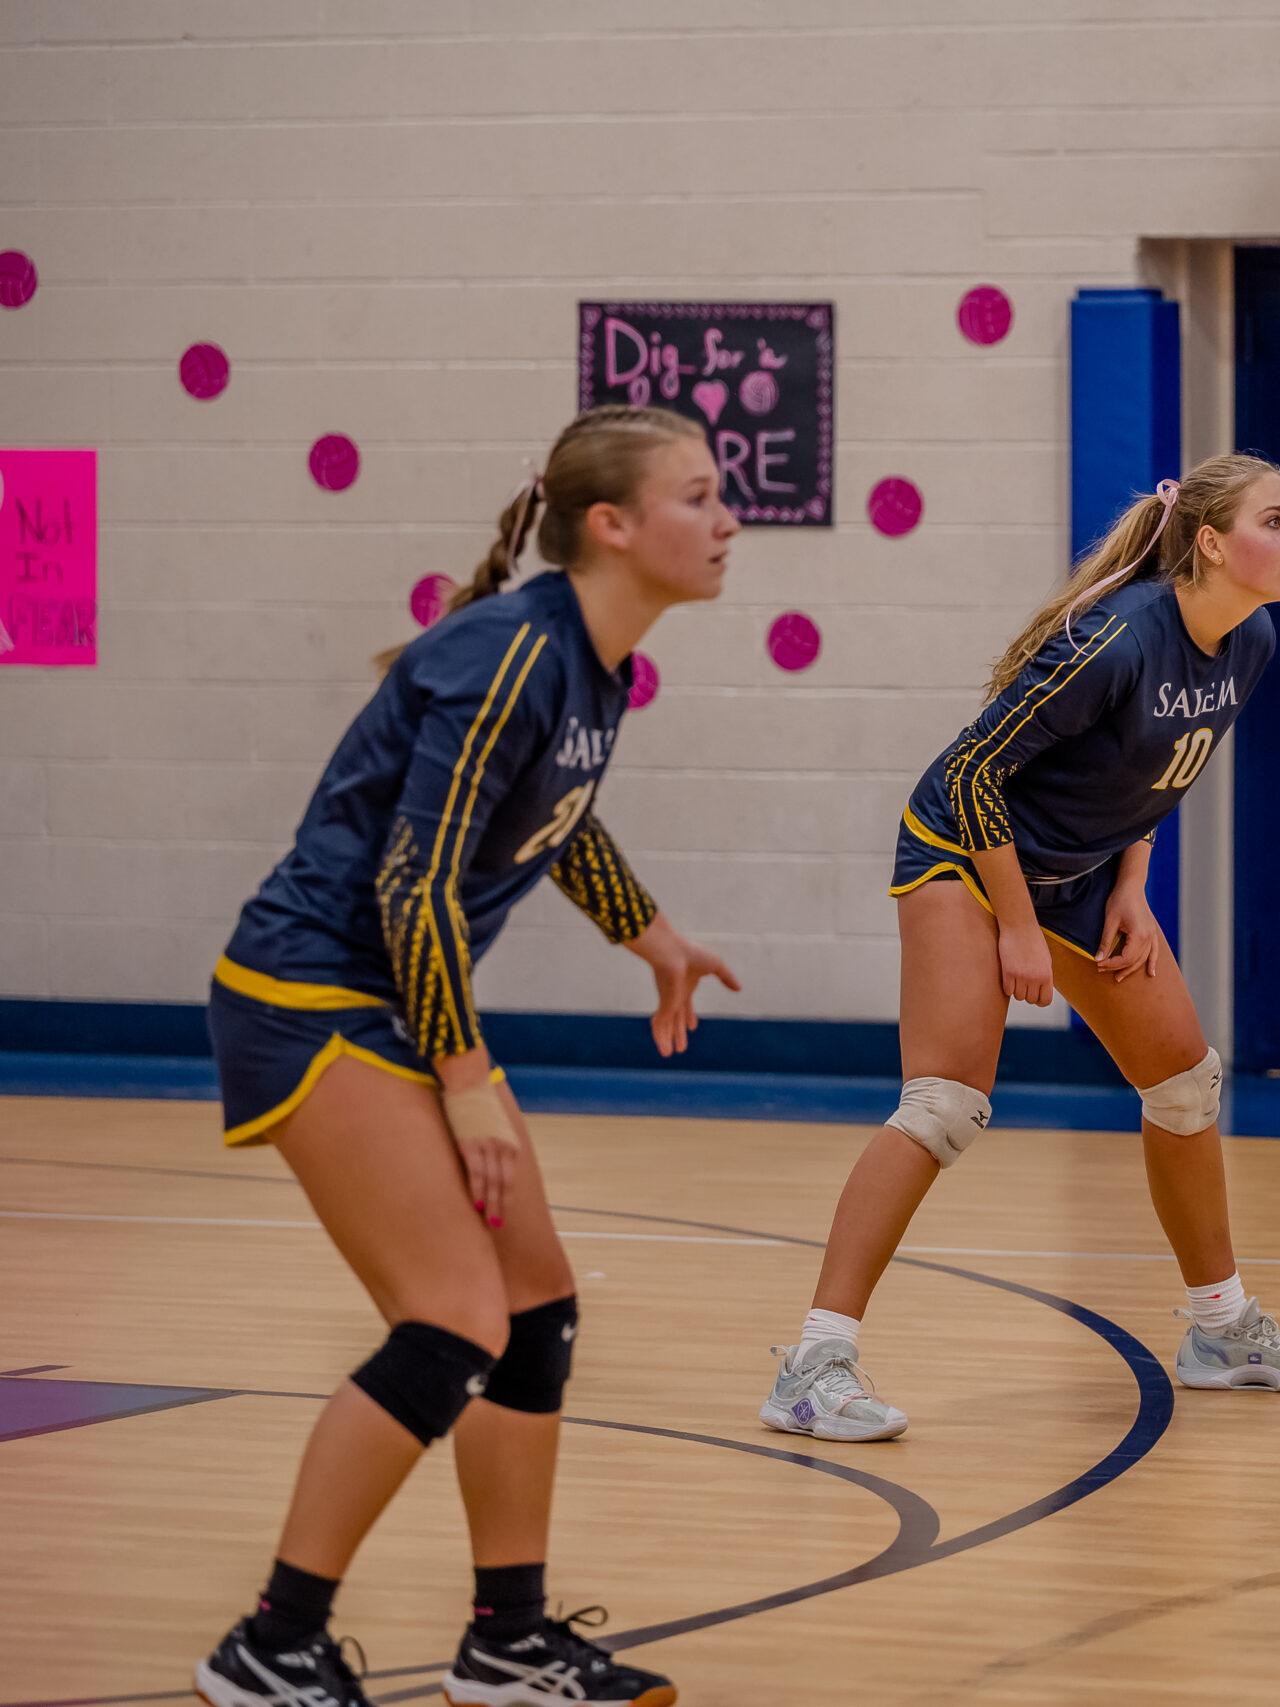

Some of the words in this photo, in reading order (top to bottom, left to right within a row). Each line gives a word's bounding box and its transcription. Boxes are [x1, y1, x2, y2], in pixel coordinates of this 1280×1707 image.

[604, 316, 697, 399] Dig
[702, 328, 745, 376] for
[716, 430, 797, 500] RE
[16, 497, 78, 546] Not
[15, 552, 63, 584] In
[1153, 676, 1239, 718] SALEM
[1151, 727, 1213, 790] 10
